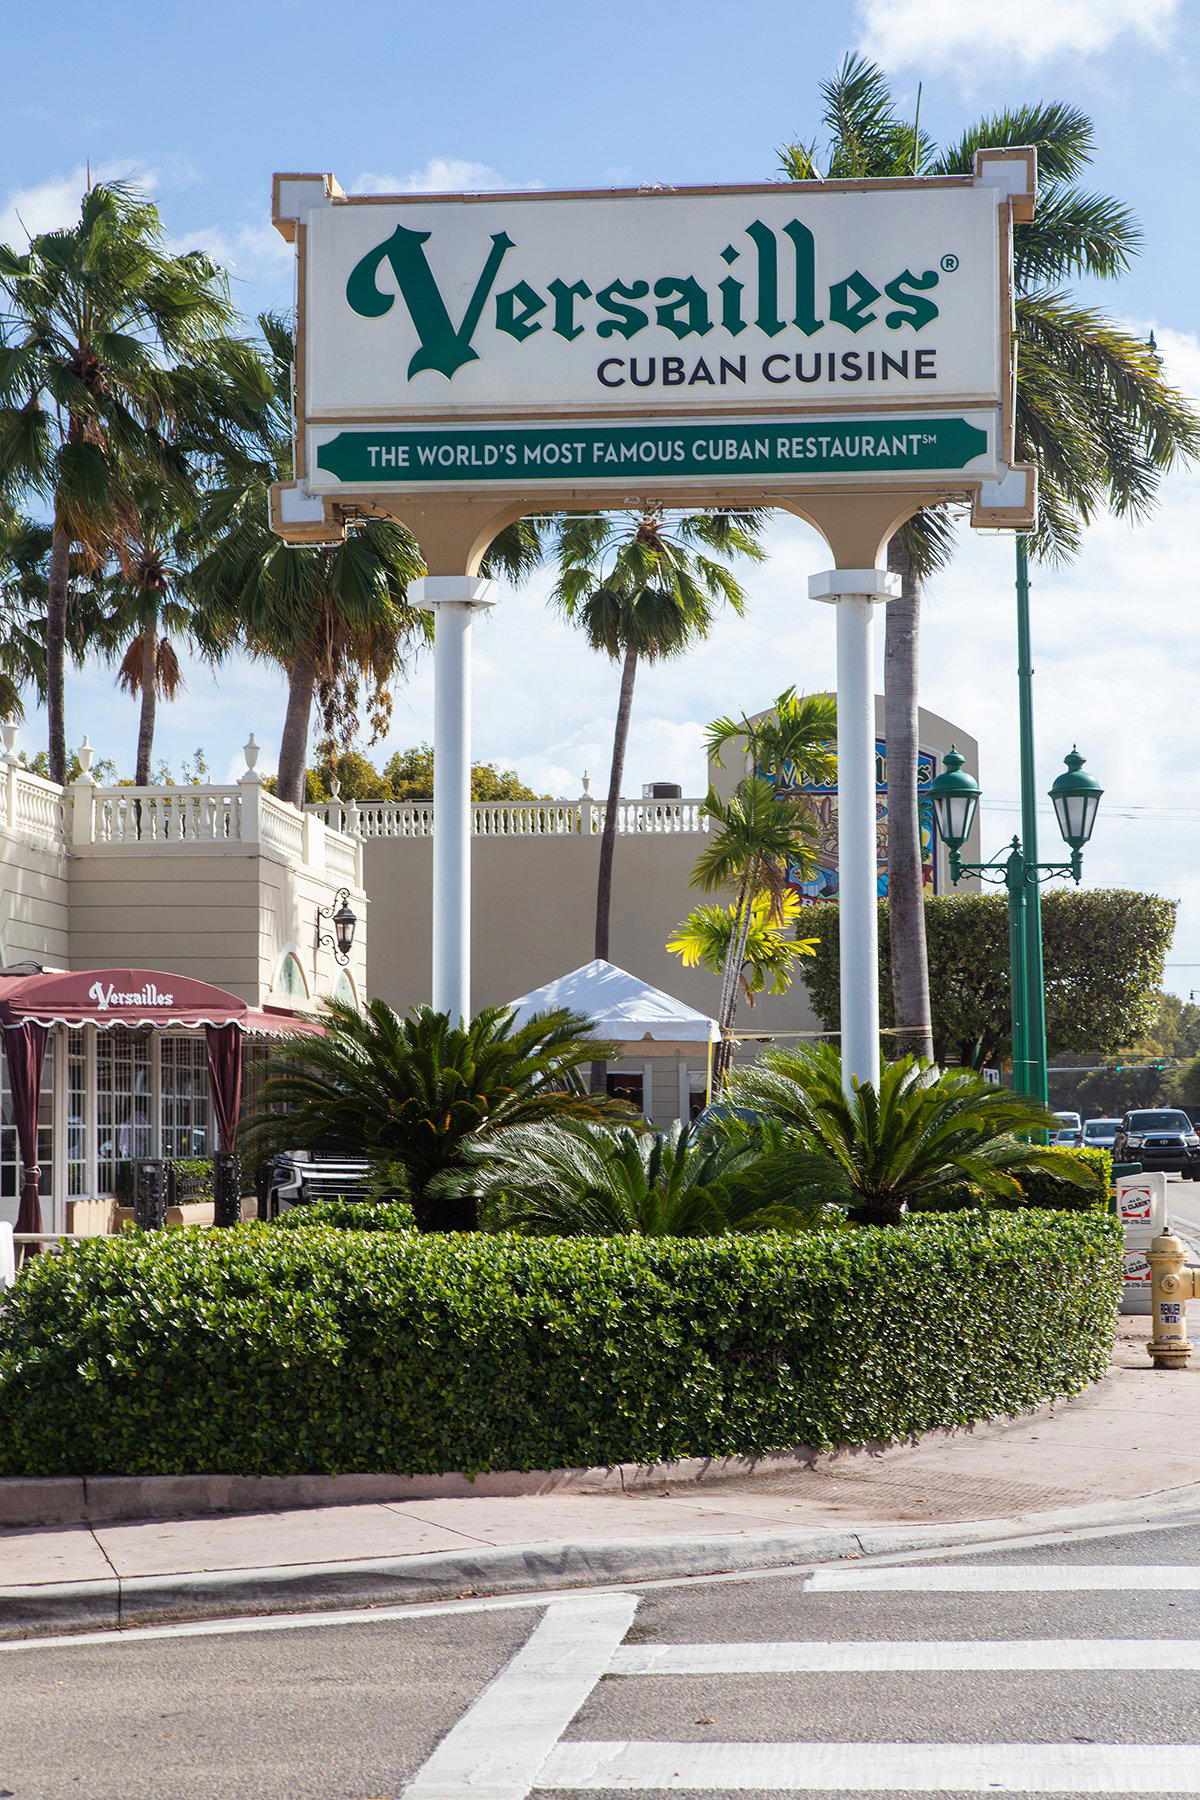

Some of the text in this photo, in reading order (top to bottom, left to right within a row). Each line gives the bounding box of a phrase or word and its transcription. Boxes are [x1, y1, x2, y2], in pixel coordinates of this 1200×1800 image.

[346, 218, 939, 381] Versailles
[596, 349, 938, 388] CUBAN CUISINE
[367, 446, 410, 467] THE
[416, 444, 518, 467] WORLD'S
[523, 444, 586, 464] MOST
[593, 442, 685, 462] FAMOUS
[692, 439, 769, 460] CUBAN
[88, 981, 174, 1011] Versailles
